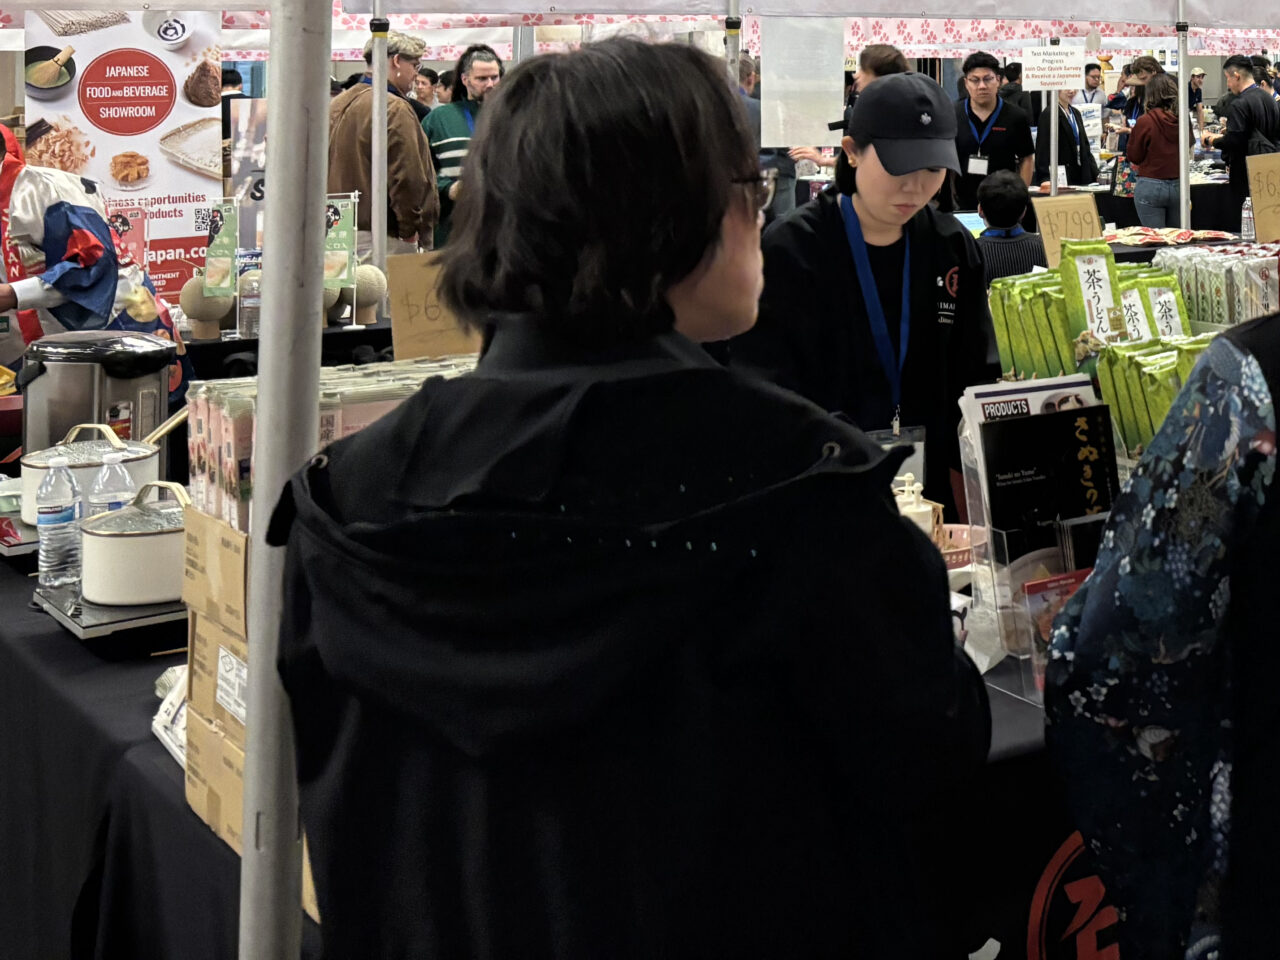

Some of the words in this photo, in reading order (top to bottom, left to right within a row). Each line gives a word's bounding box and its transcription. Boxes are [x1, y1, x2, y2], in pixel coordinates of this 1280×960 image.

[105, 65, 150, 78] JAPANESE
[86, 86, 112, 99] FOOD
[112, 89, 123, 97] AND
[123, 85, 169, 97] BEVERAGE
[100, 106, 156, 118] SHOWROOM
[145, 208, 184, 220] roducts
[1042, 209, 1095, 240] $7.99
[400, 288, 441, 327] $6
[1083, 269, 1109, 333] 茶うどん
[983, 401, 1029, 420] PRODUCTS
